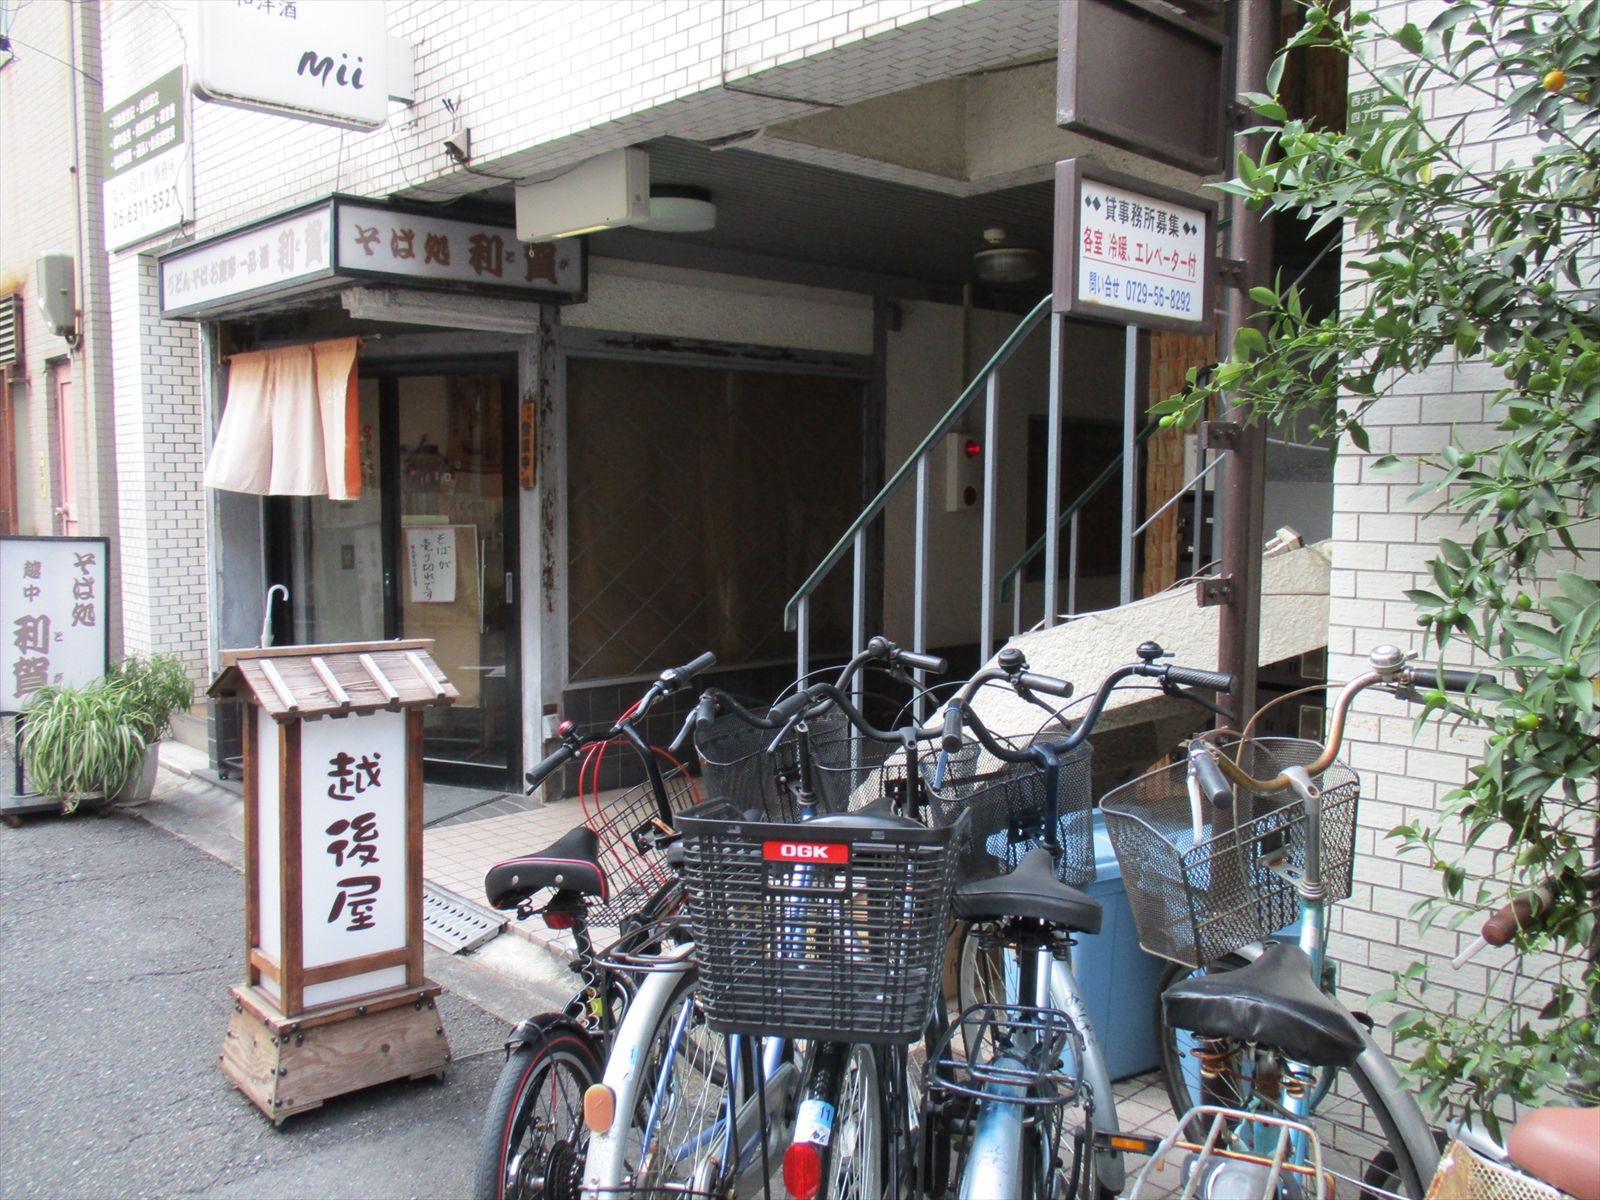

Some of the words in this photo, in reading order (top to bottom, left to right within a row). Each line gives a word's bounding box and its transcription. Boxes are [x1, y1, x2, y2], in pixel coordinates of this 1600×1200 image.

[297, 51, 364, 90] Mii
[1105, 195, 1180, 238] 貸事務所募集
[1083, 226, 1104, 256] 各室
[1089, 271, 1120, 299] 問い合せ
[1126, 279, 1191, 313] 0729-56-8292
[23, 560, 42, 602] 越中
[71, 552, 97, 627] そば処
[325, 751, 382, 932] 越後屋
[780, 844, 829, 859] OGK
